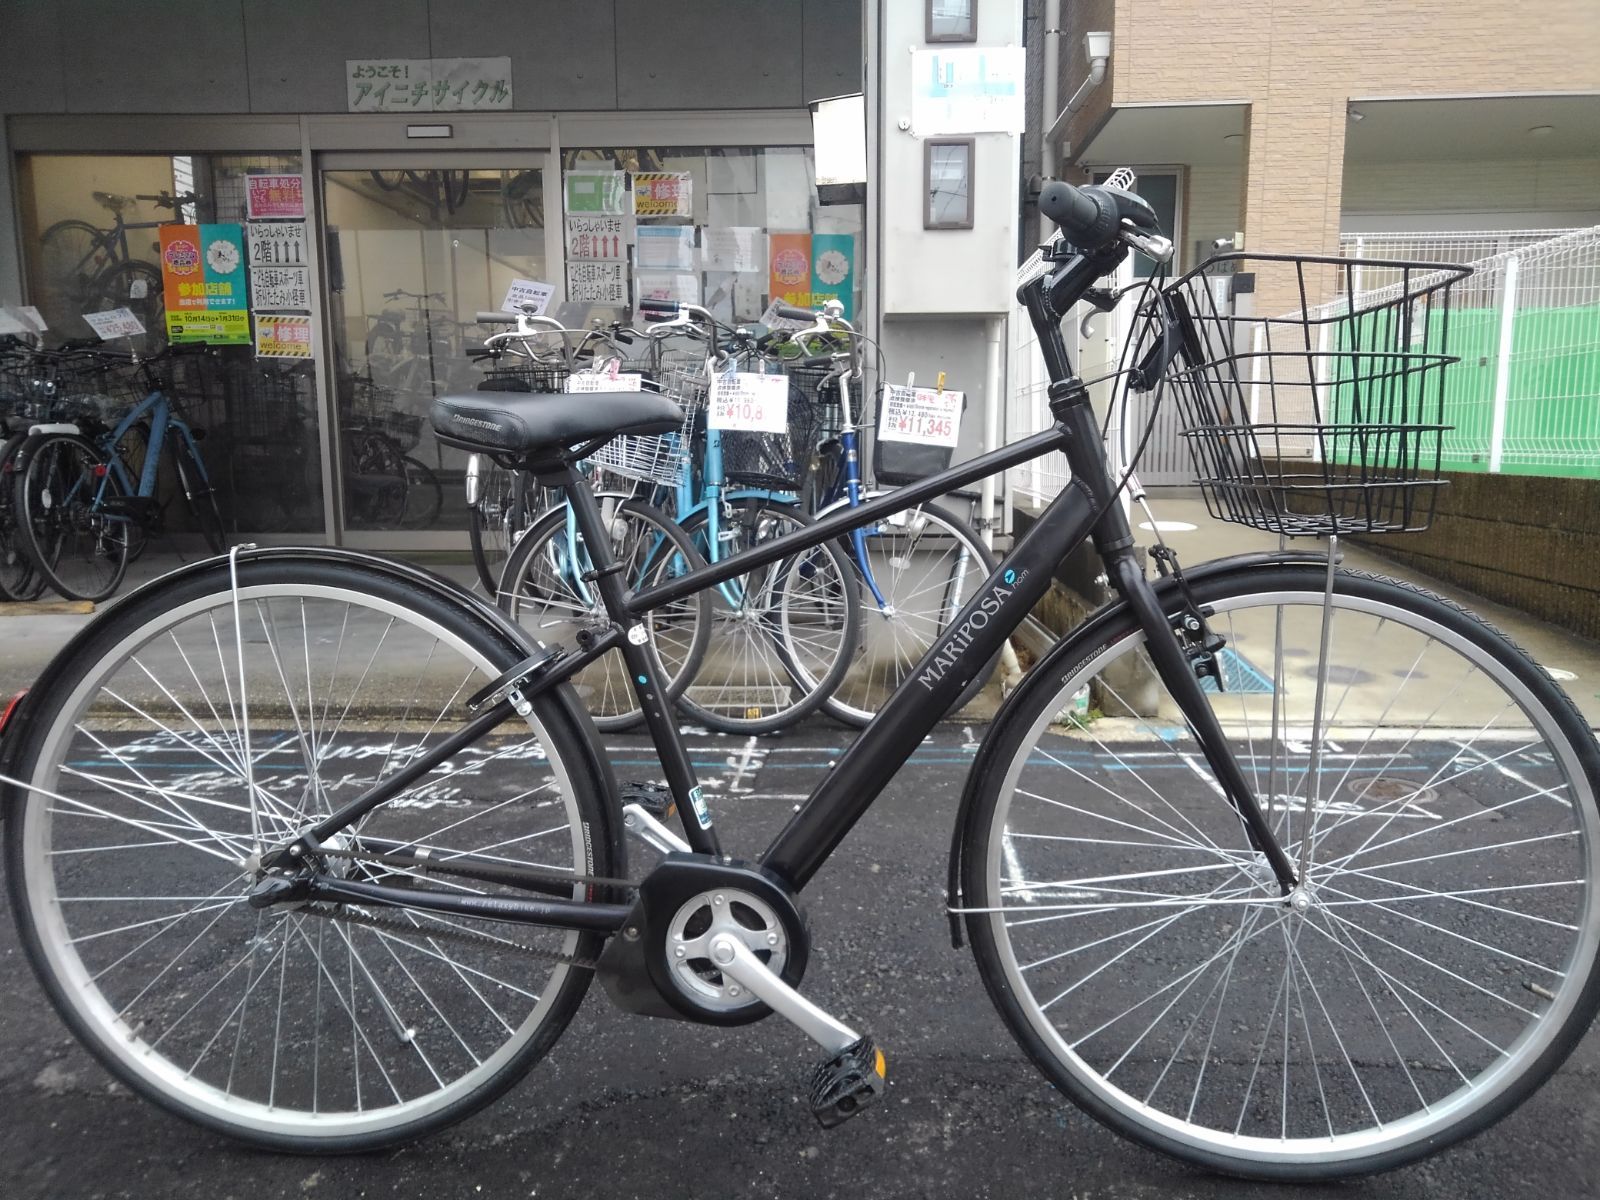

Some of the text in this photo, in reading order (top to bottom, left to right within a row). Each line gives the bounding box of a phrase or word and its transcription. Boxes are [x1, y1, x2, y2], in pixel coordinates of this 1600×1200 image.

[353, 79, 509, 106] アイニチサイクル
[250, 224, 302, 238] いらっしゃいませ
[569, 218, 621, 232] いらっしゃいませ
[253, 240, 272, 263] 2階
[572, 234, 590, 258] 2階
[178, 282, 232, 297] 参加店舗
[255, 288, 306, 306] 折りたたみ小径車
[571, 284, 622, 301] 折りたたみ小径車
[277, 325, 310, 342] 修理
[898, 416, 952, 437] ¥11,345
